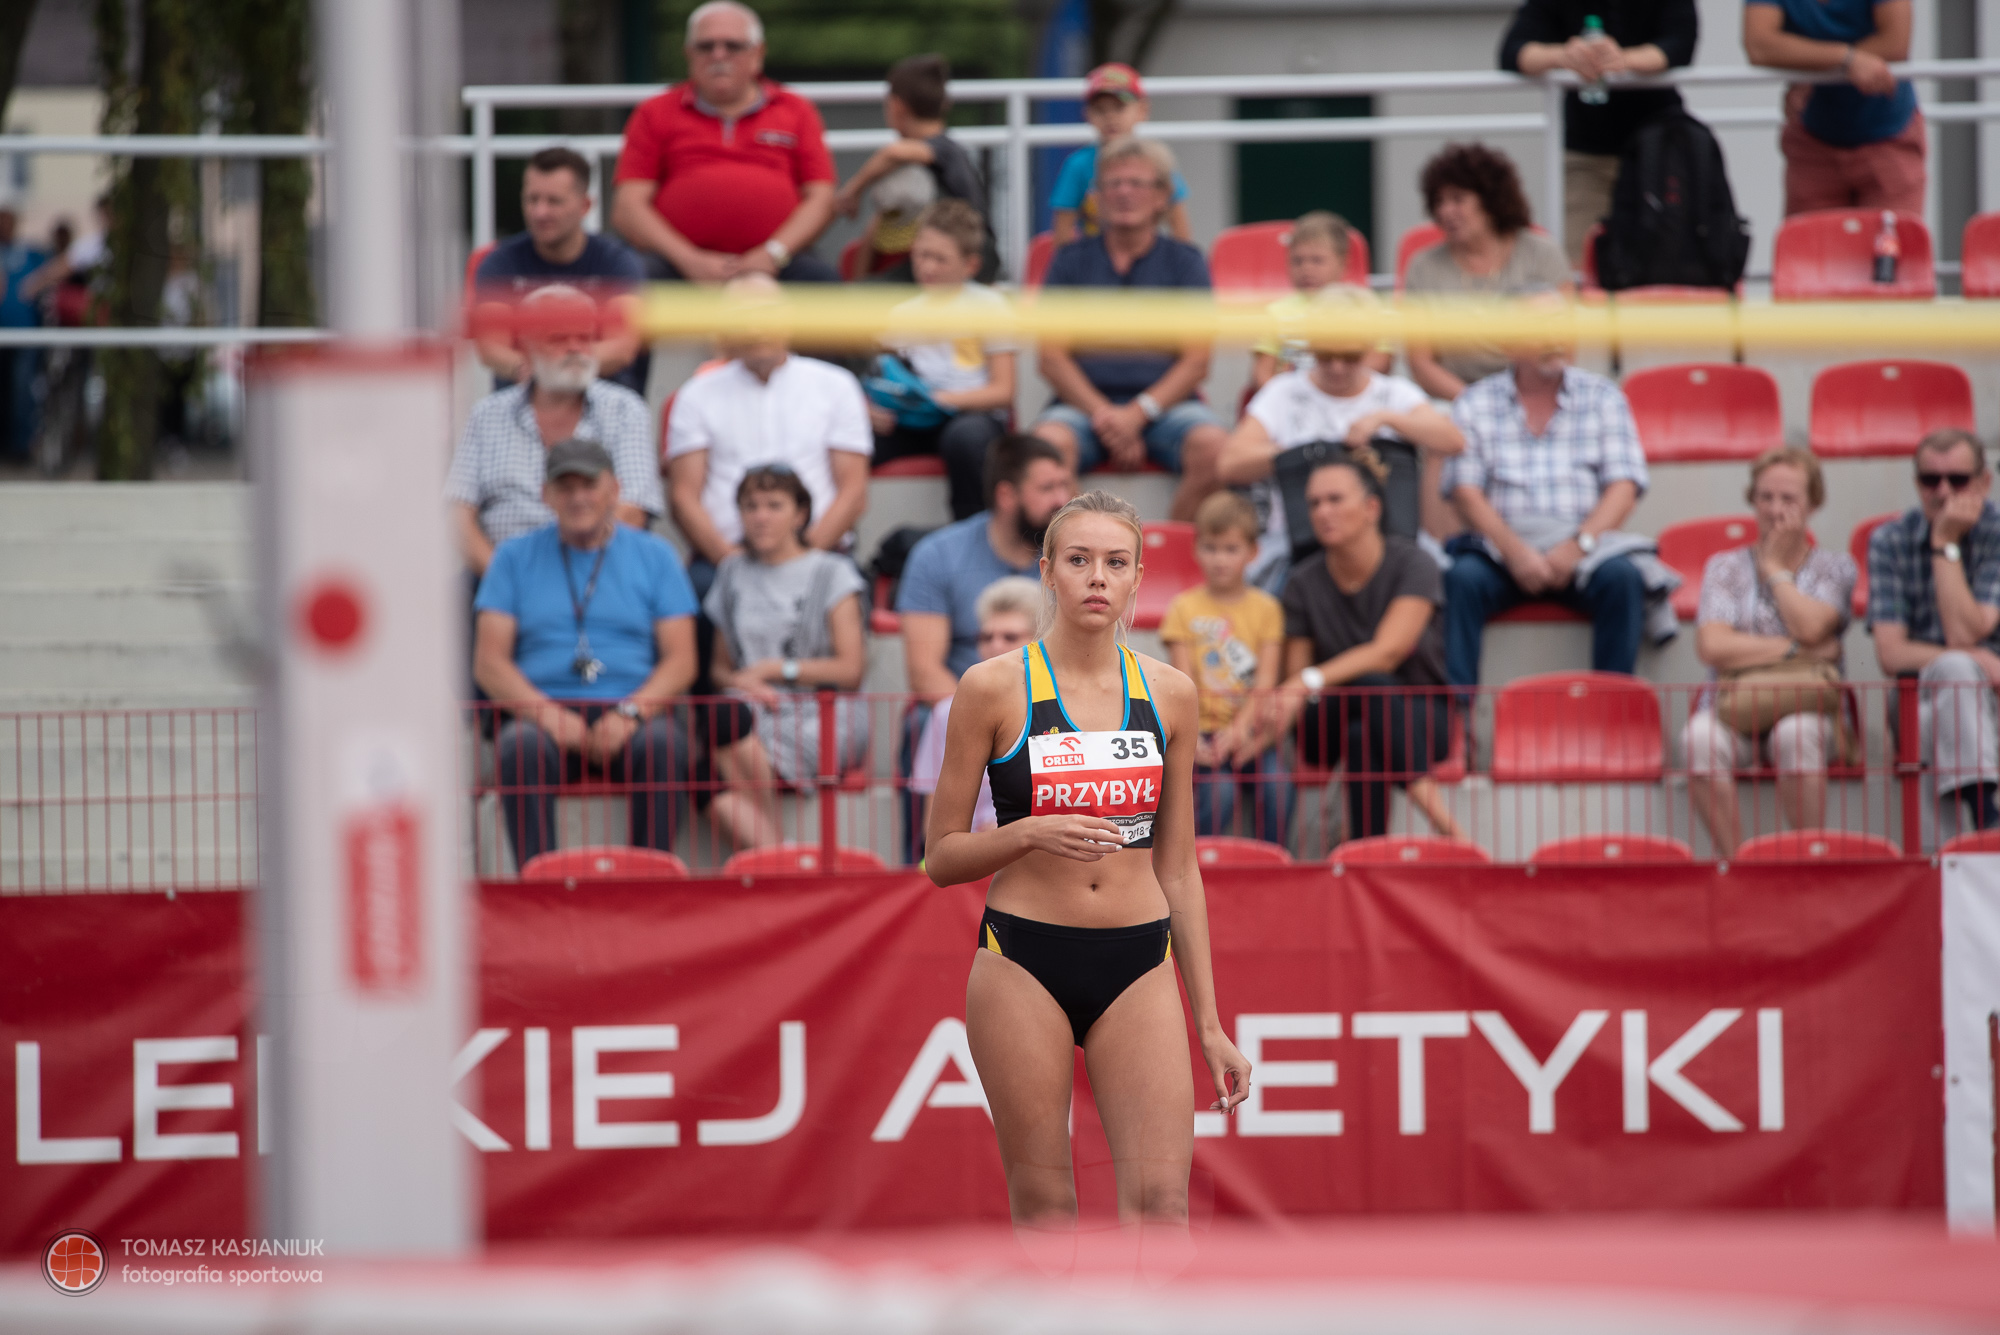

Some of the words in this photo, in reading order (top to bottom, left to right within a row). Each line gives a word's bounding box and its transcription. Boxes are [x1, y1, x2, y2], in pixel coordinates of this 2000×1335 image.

[1044, 755, 1083, 767] ORLEN
[1110, 737, 1149, 760] 35
[1036, 777, 1156, 808] PRZYBYŁ
[15, 1020, 807, 1165] LEKIEJ
[870, 1006, 1785, 1143] AETYKI
